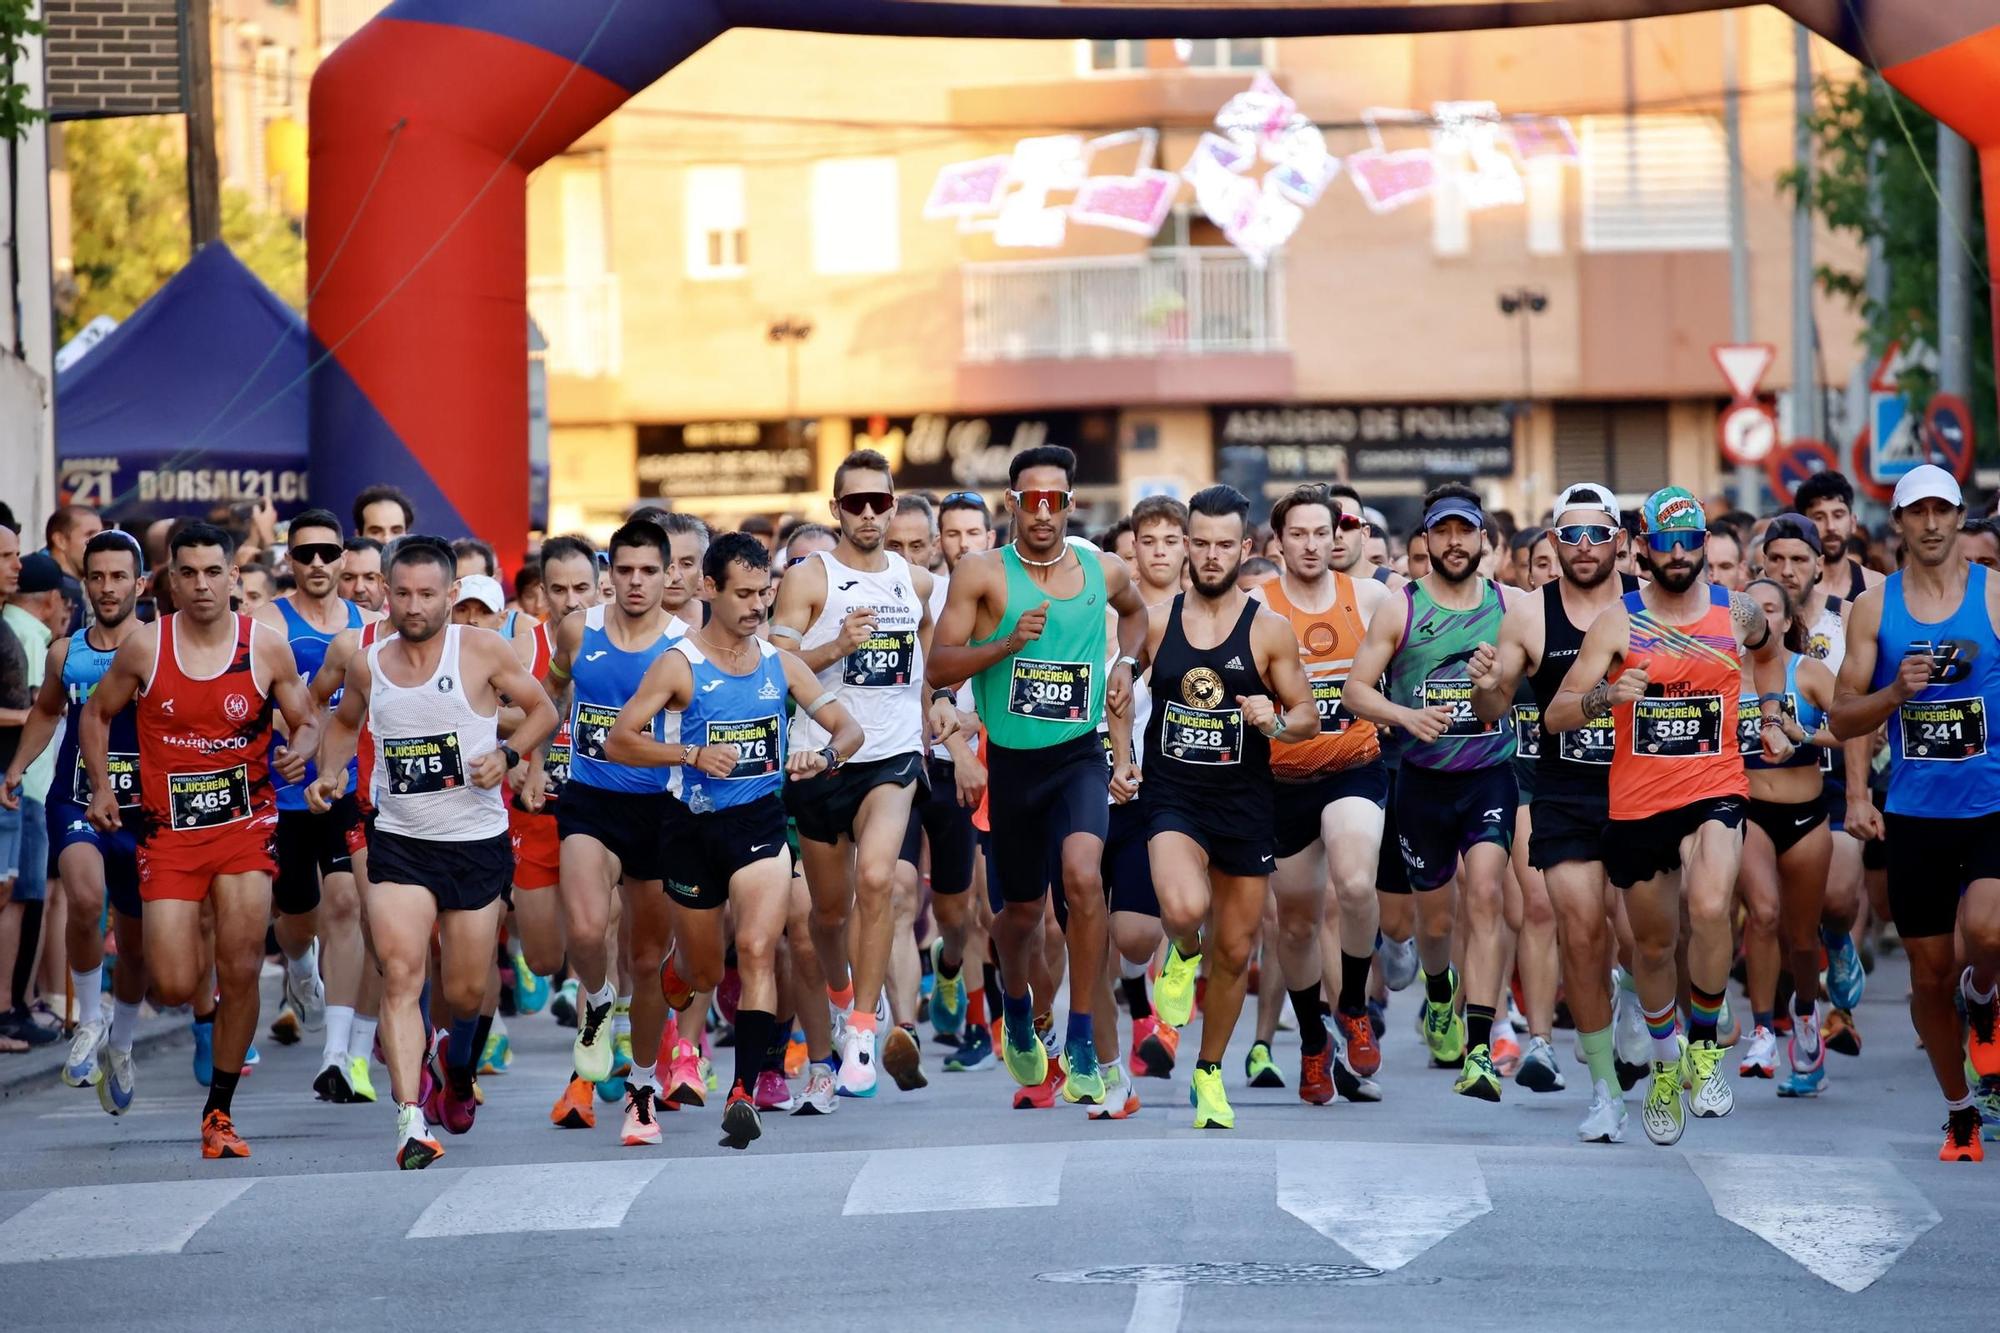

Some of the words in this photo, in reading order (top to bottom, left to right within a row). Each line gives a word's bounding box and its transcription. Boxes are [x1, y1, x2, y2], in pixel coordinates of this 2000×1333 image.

[67, 469, 113, 506] 21
[857, 637, 901, 650] JUCEREÑA
[863, 650, 900, 669] 120
[1548, 648, 1580, 657] SCOT
[1014, 667, 1074, 683] ALJUCEREÑA
[1032, 681, 1073, 702] 308
[1315, 699, 1341, 715] 07
[1446, 700, 1475, 718] 52
[1636, 705, 1702, 719] ALJUCEREÑA
[1902, 708, 1965, 722] ALJUCEREÑA
[1166, 711, 1224, 730] ALJUCEREÑA
[1656, 720, 1701, 738] 588
[709, 726, 767, 742] ALJUCEREÑA
[1181, 727, 1223, 747] 528
[1921, 721, 1963, 740] 241
[384, 742, 441, 758] ALJUCEREÑA
[400, 755, 443, 776] 715
[108, 773, 133, 790] 16
[171, 777, 231, 794] ALJUCEREÑA
[191, 788, 232, 810] 465
